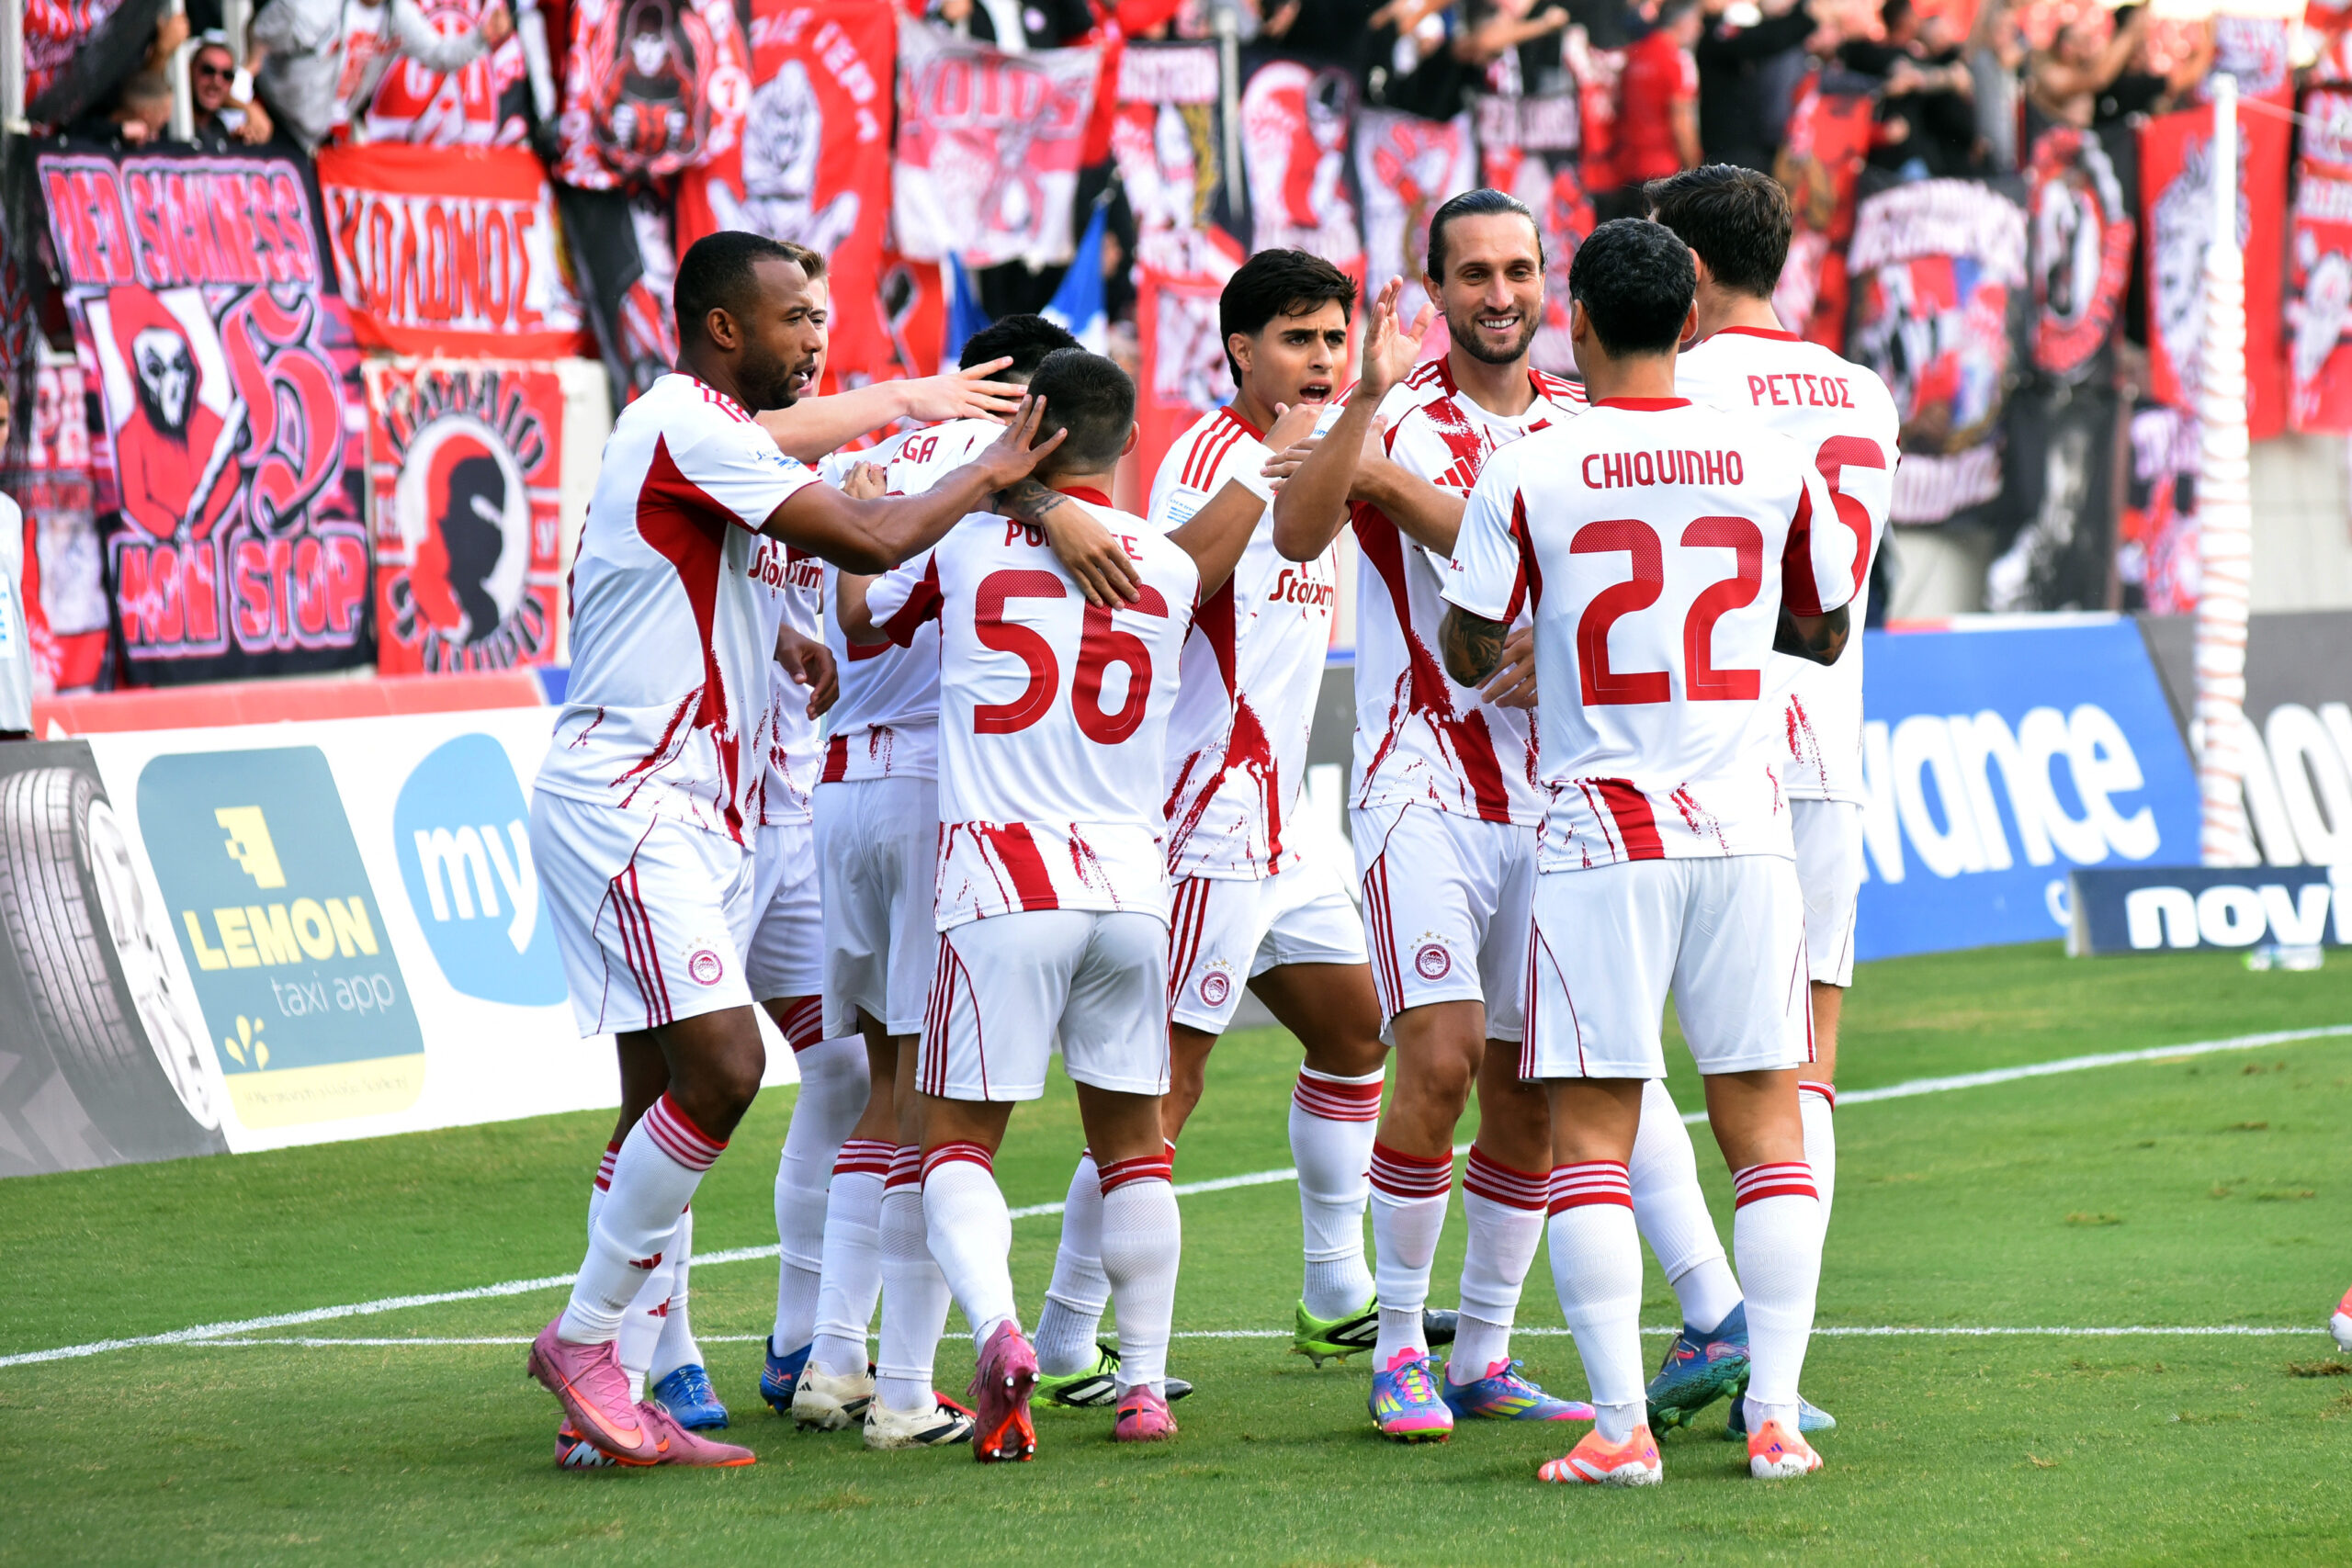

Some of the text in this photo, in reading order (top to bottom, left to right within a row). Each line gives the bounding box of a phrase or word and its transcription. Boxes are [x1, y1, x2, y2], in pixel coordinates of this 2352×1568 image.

[44, 165, 317, 287] RED SICKNESS
[334, 188, 544, 324] ΚΟΛΩΝΟΣ
[1747, 373, 1856, 410] ΡΕΤΣΟΣ
[1582, 449, 1745, 490] CHIQUINHO
[114, 533, 222, 649] NON
[233, 531, 368, 645] STOP
[1569, 515, 1764, 707] 22
[974, 570, 1170, 745] 56
[1861, 703, 2162, 886] vance
[182, 895, 379, 971] LEMON
[413, 818, 540, 955] my
[270, 969, 396, 1018] taxi app
